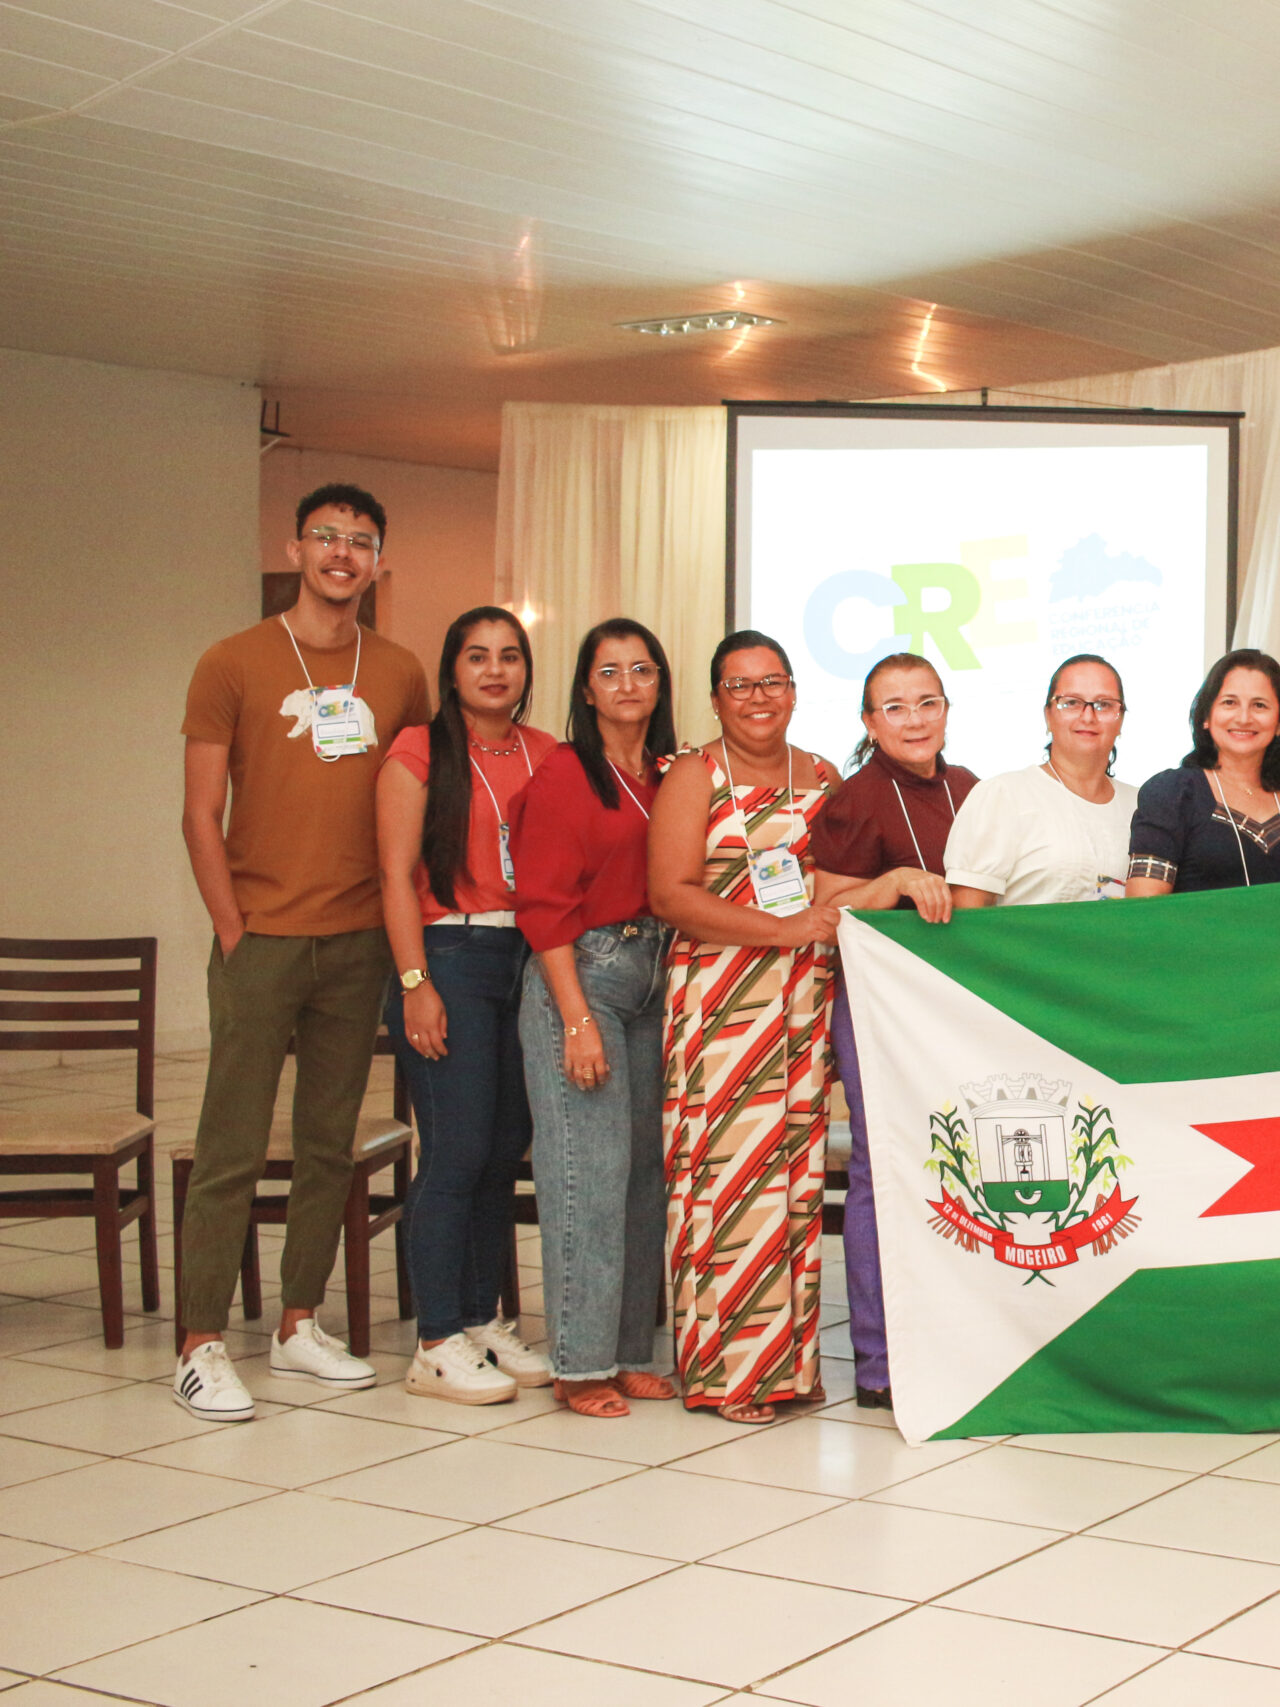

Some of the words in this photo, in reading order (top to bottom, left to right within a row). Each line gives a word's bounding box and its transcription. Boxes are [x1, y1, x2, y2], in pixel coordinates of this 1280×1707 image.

[803, 534, 1039, 680] CRE
[942, 1203, 953, 1214] 12
[959, 1215, 993, 1242] DEZEMBRO
[1091, 1212, 1114, 1232] 1961
[1005, 1245, 1067, 1266] MOGEIRO
